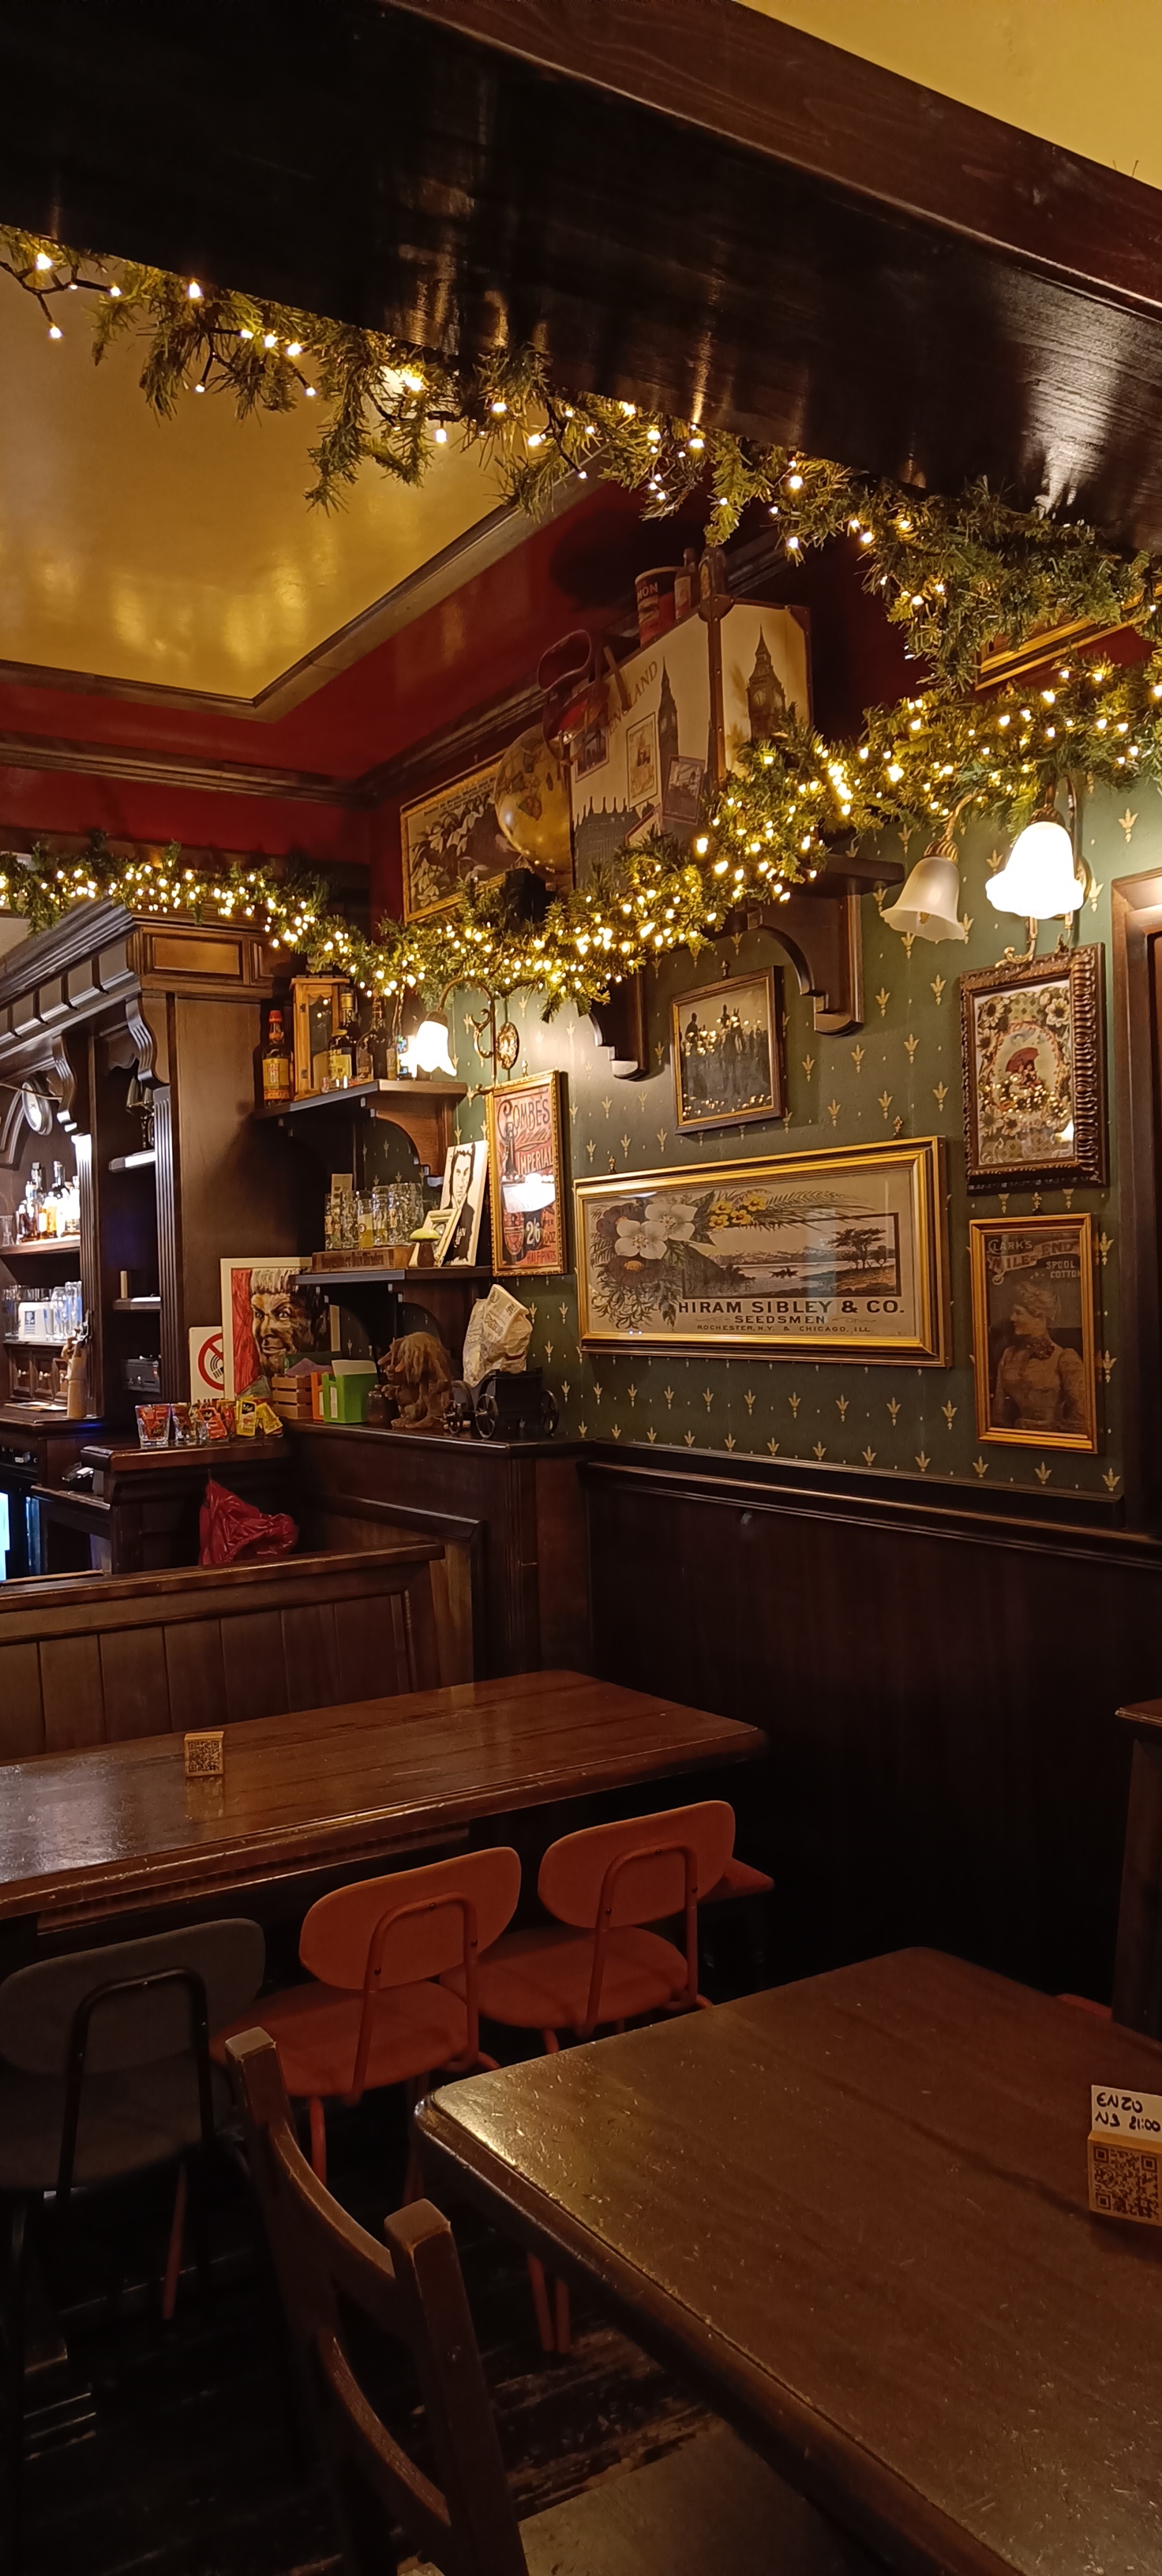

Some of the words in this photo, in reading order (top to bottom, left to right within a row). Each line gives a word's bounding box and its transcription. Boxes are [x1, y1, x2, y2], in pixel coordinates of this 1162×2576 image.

[609, 660, 658, 736] ENLAND
[515, 1146, 553, 1175] IMPERIAL
[526, 1217, 541, 1246] 2/6
[988, 1239, 1033, 1255] CLARK'S
[1045, 1260, 1076, 1270] SPOOL
[679, 1301, 742, 1313] HIRAM
[752, 1300, 833, 1313] SIBLEY
[841, 1300, 858, 1313] &
[866, 1299, 905, 1313] CO.
[734, 1315, 825, 1324] SEEDSMEN
[1096, 2091, 1143, 2114] ENZO
